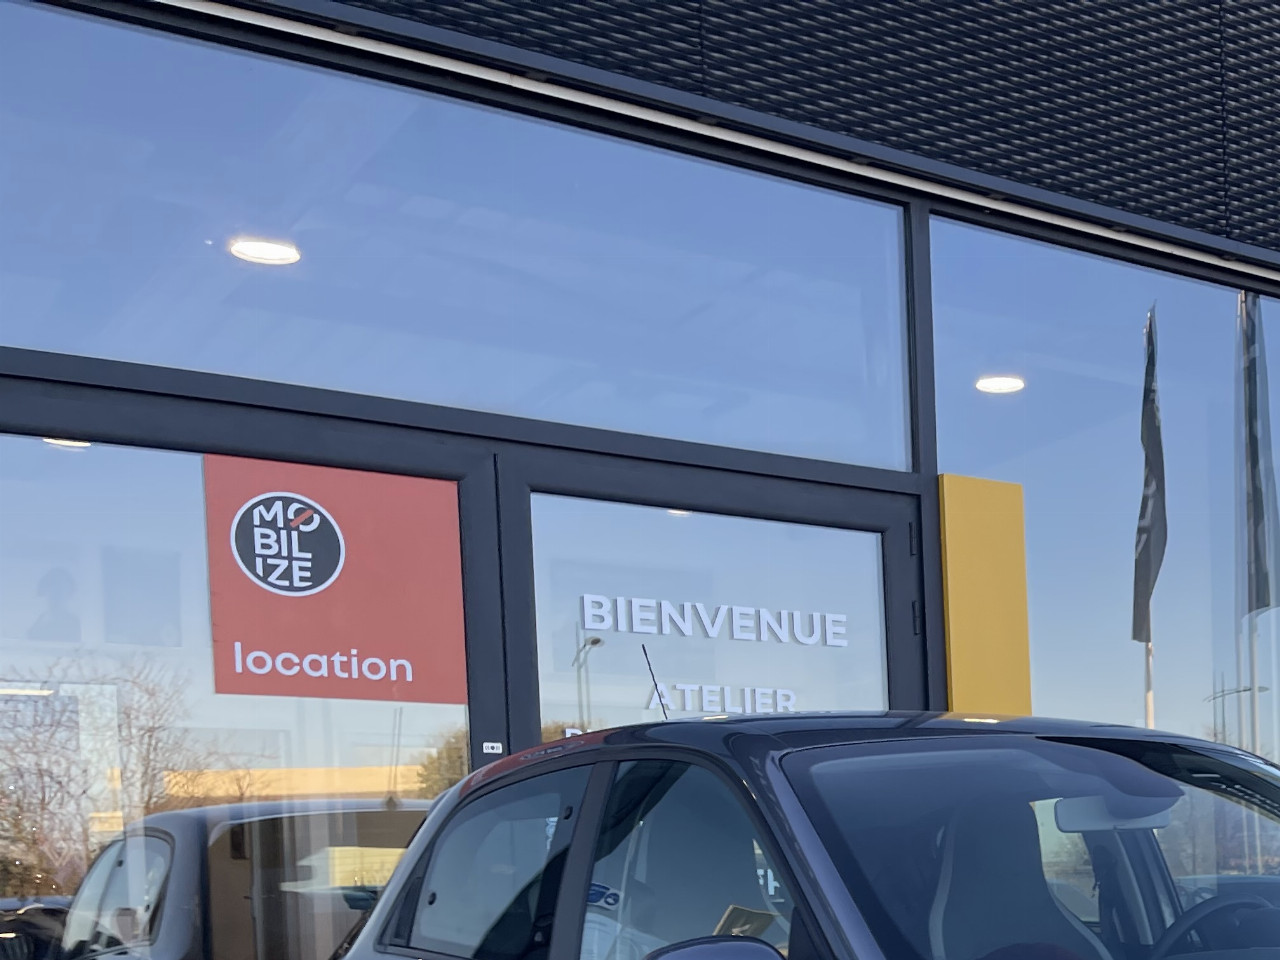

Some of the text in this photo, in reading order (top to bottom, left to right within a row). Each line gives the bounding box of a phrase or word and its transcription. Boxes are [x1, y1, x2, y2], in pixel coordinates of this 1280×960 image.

[580, 593, 849, 648] BIENVENUE
[234, 641, 413, 682] location
[647, 683, 798, 714] ATELIER
